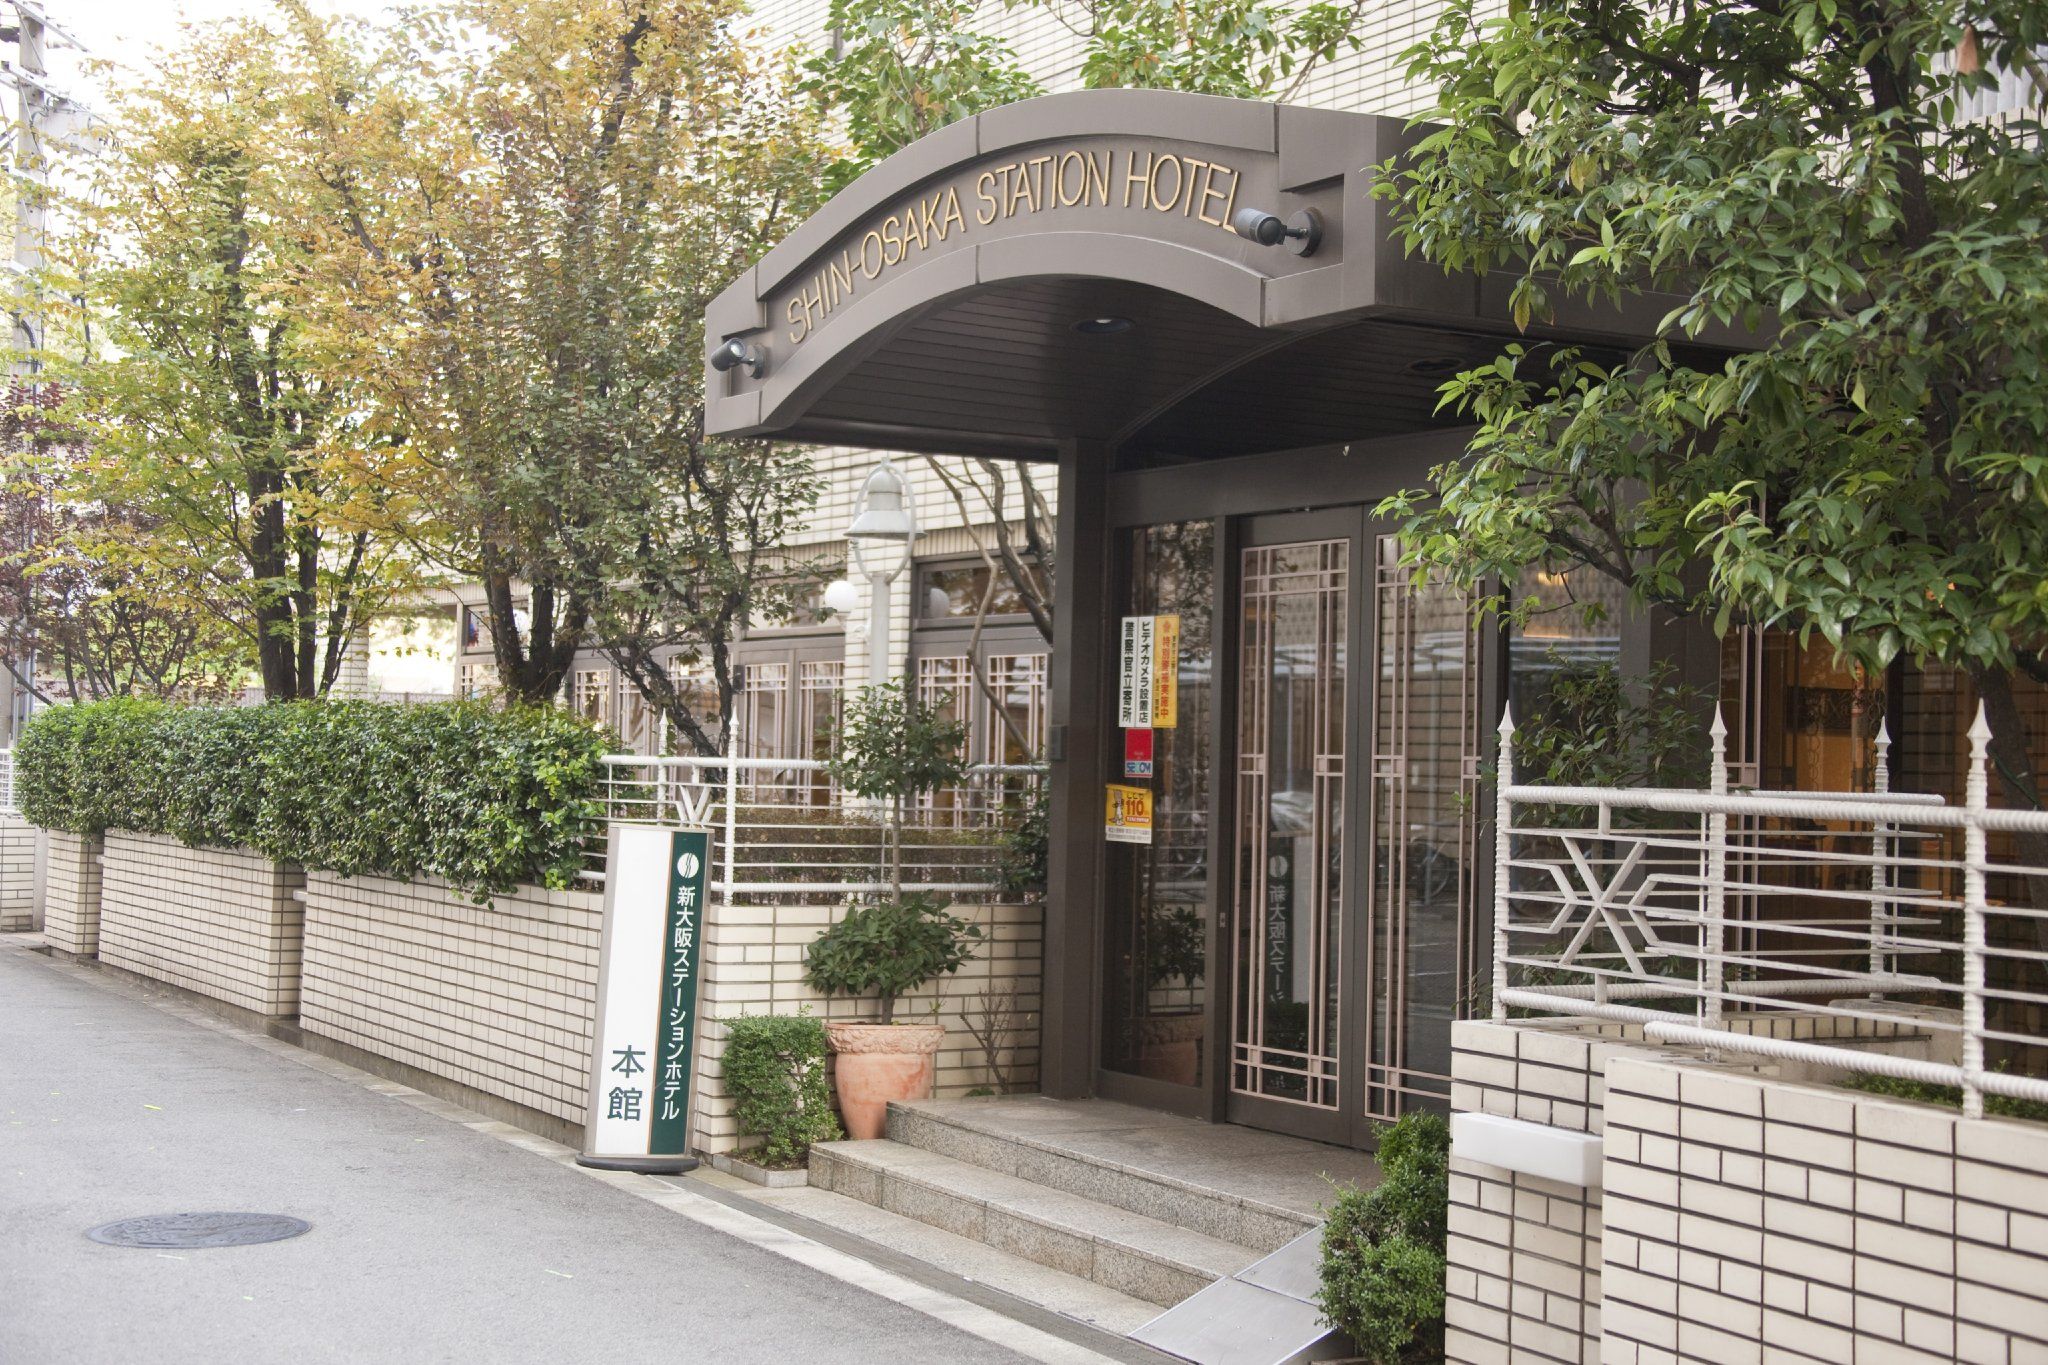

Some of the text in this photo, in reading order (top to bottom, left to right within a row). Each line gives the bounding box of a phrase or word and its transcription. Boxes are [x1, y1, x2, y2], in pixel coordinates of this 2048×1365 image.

[786, 150, 1243, 344] SHIN-OSAKA STATION HOTEL
[1122, 621, 1135, 723] 警察官立寄所
[1139, 621, 1151, 724] ビデオカメラ設置店
[1126, 761, 1152, 773] SECOM
[660, 885, 696, 1121] 新大阪ステーションホテル
[606, 1044, 647, 1122] 本館
